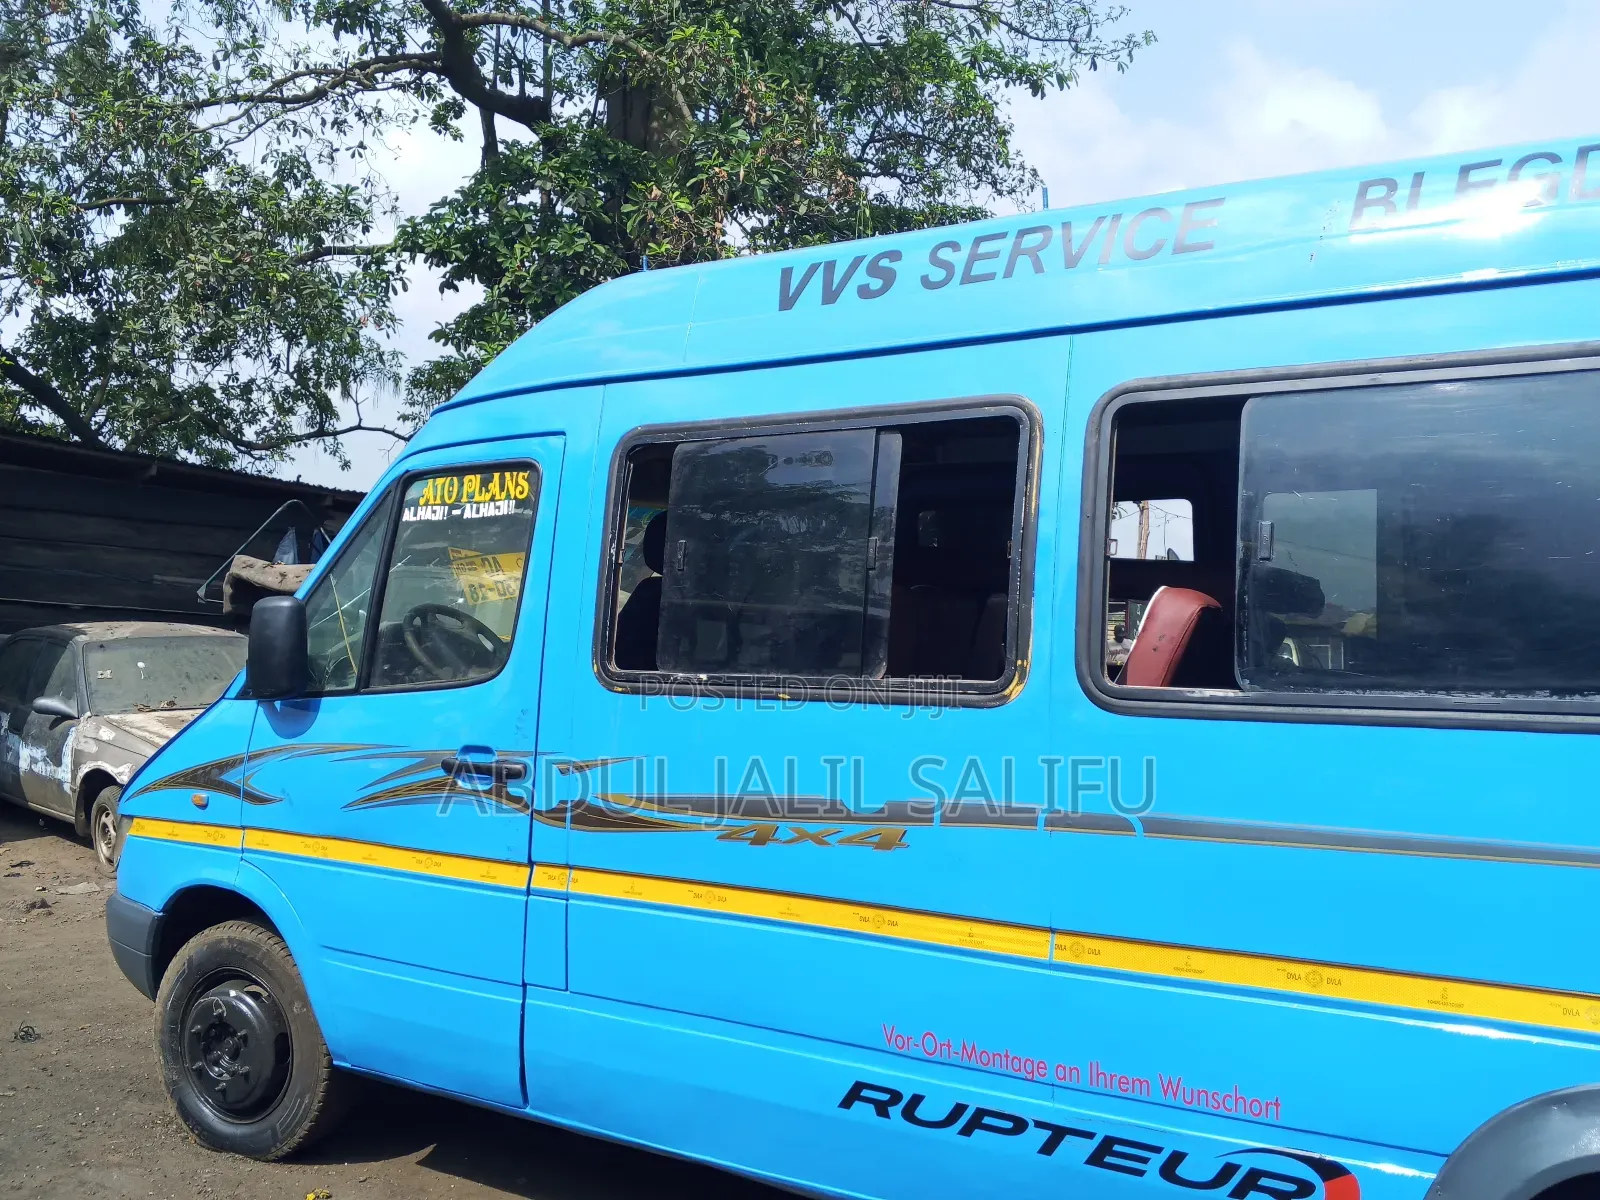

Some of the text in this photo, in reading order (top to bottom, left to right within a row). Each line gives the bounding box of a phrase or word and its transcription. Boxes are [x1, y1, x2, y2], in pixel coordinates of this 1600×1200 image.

[778, 250, 903, 312] VVS
[920, 197, 1227, 290] SERVICE
[419, 472, 529, 506] ATO PLANS
[1562, 1007, 1581, 1017] DVLA
[881, 1022, 1282, 1121] Vor-Ort-Montage an Ihrem Wunschort
